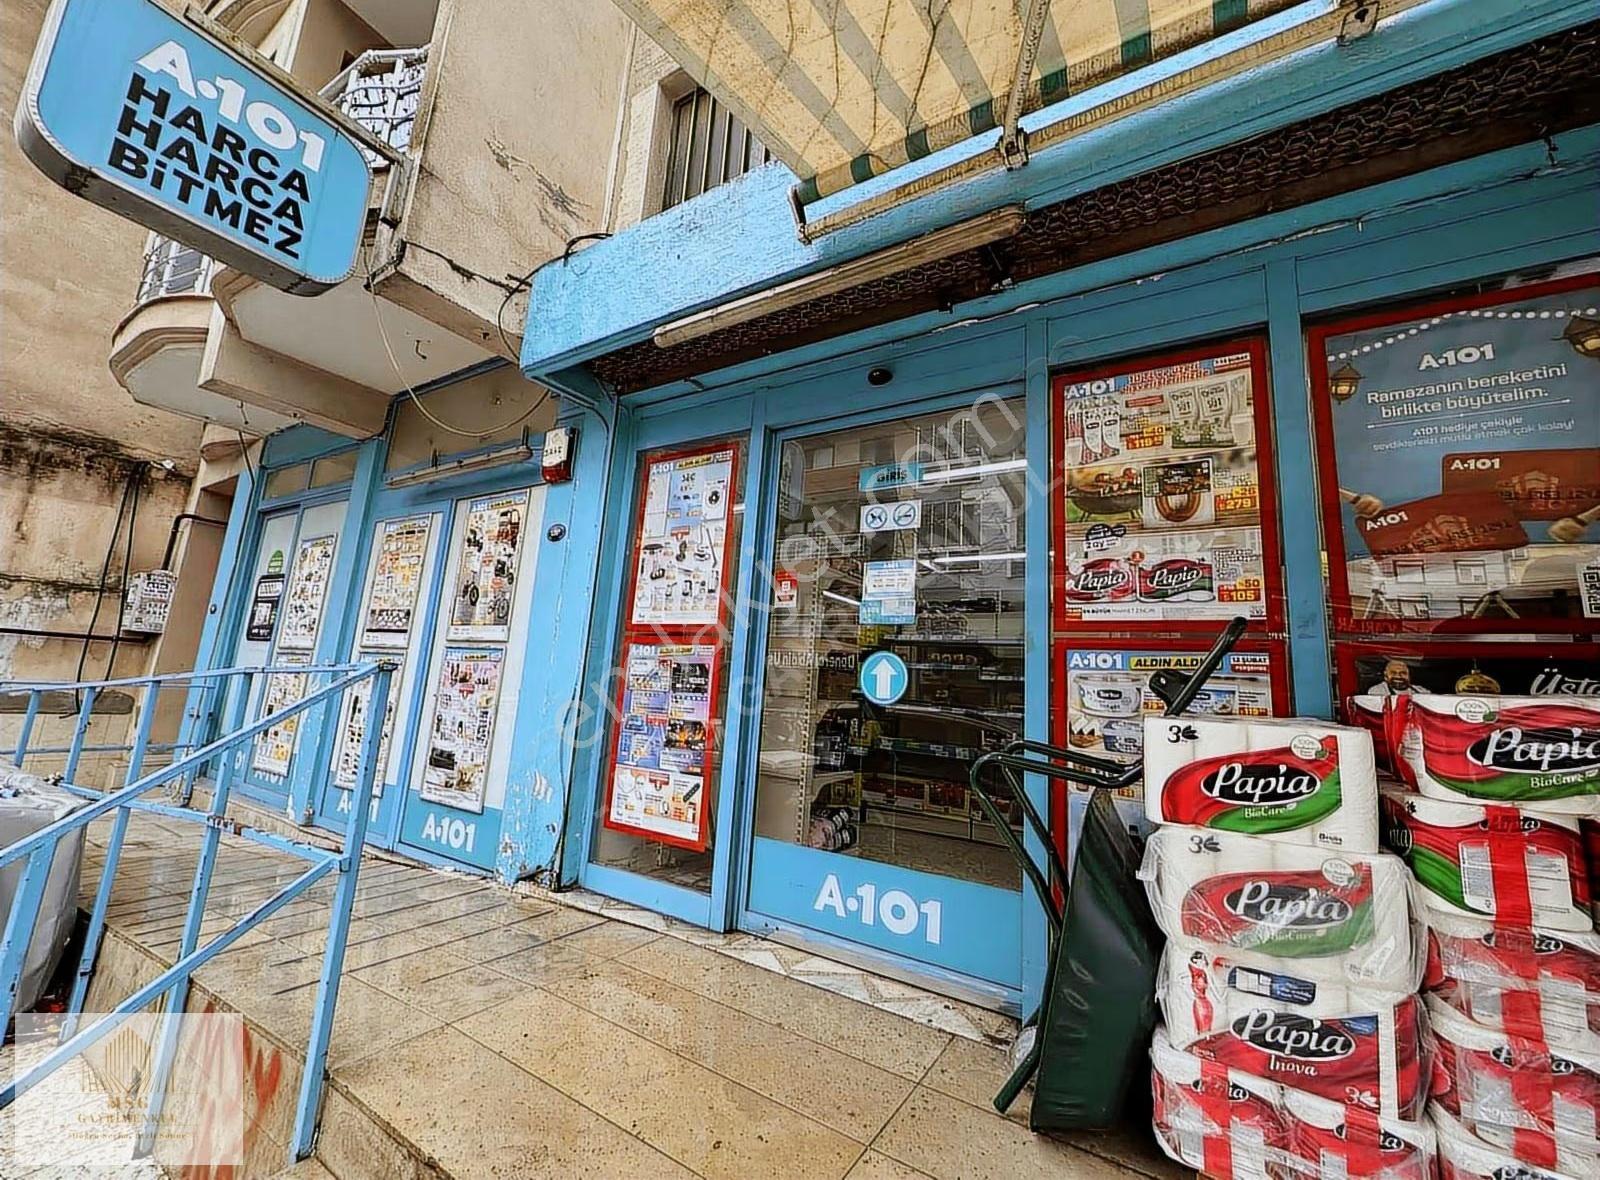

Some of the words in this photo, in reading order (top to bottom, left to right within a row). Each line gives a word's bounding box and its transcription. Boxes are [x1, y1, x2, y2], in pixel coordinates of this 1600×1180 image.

[127, 72, 310, 203] HARCA
[117, 104, 304, 231] HARCA
[1367, 378, 1463, 404] Ramazanın
[1467, 363, 1567, 388] bereketini
[1380, 396, 1442, 419] birlikte
[1078, 569, 1124, 592] Papia
[1153, 566, 1198, 588] Papia
[1135, 657, 1172, 667] ALDIN
[1167, 725, 1181, 743] 3
[1211, 762, 1315, 803] Papia
[1244, 805, 1286, 818] BioCare
[1188, 835, 1202, 854] 3
[1234, 880, 1345, 927] Papia
[1241, 1008, 1348, 1055] Papia
[1269, 1054, 1318, 1077] Inova
[1344, 1086, 1360, 1105] 3
